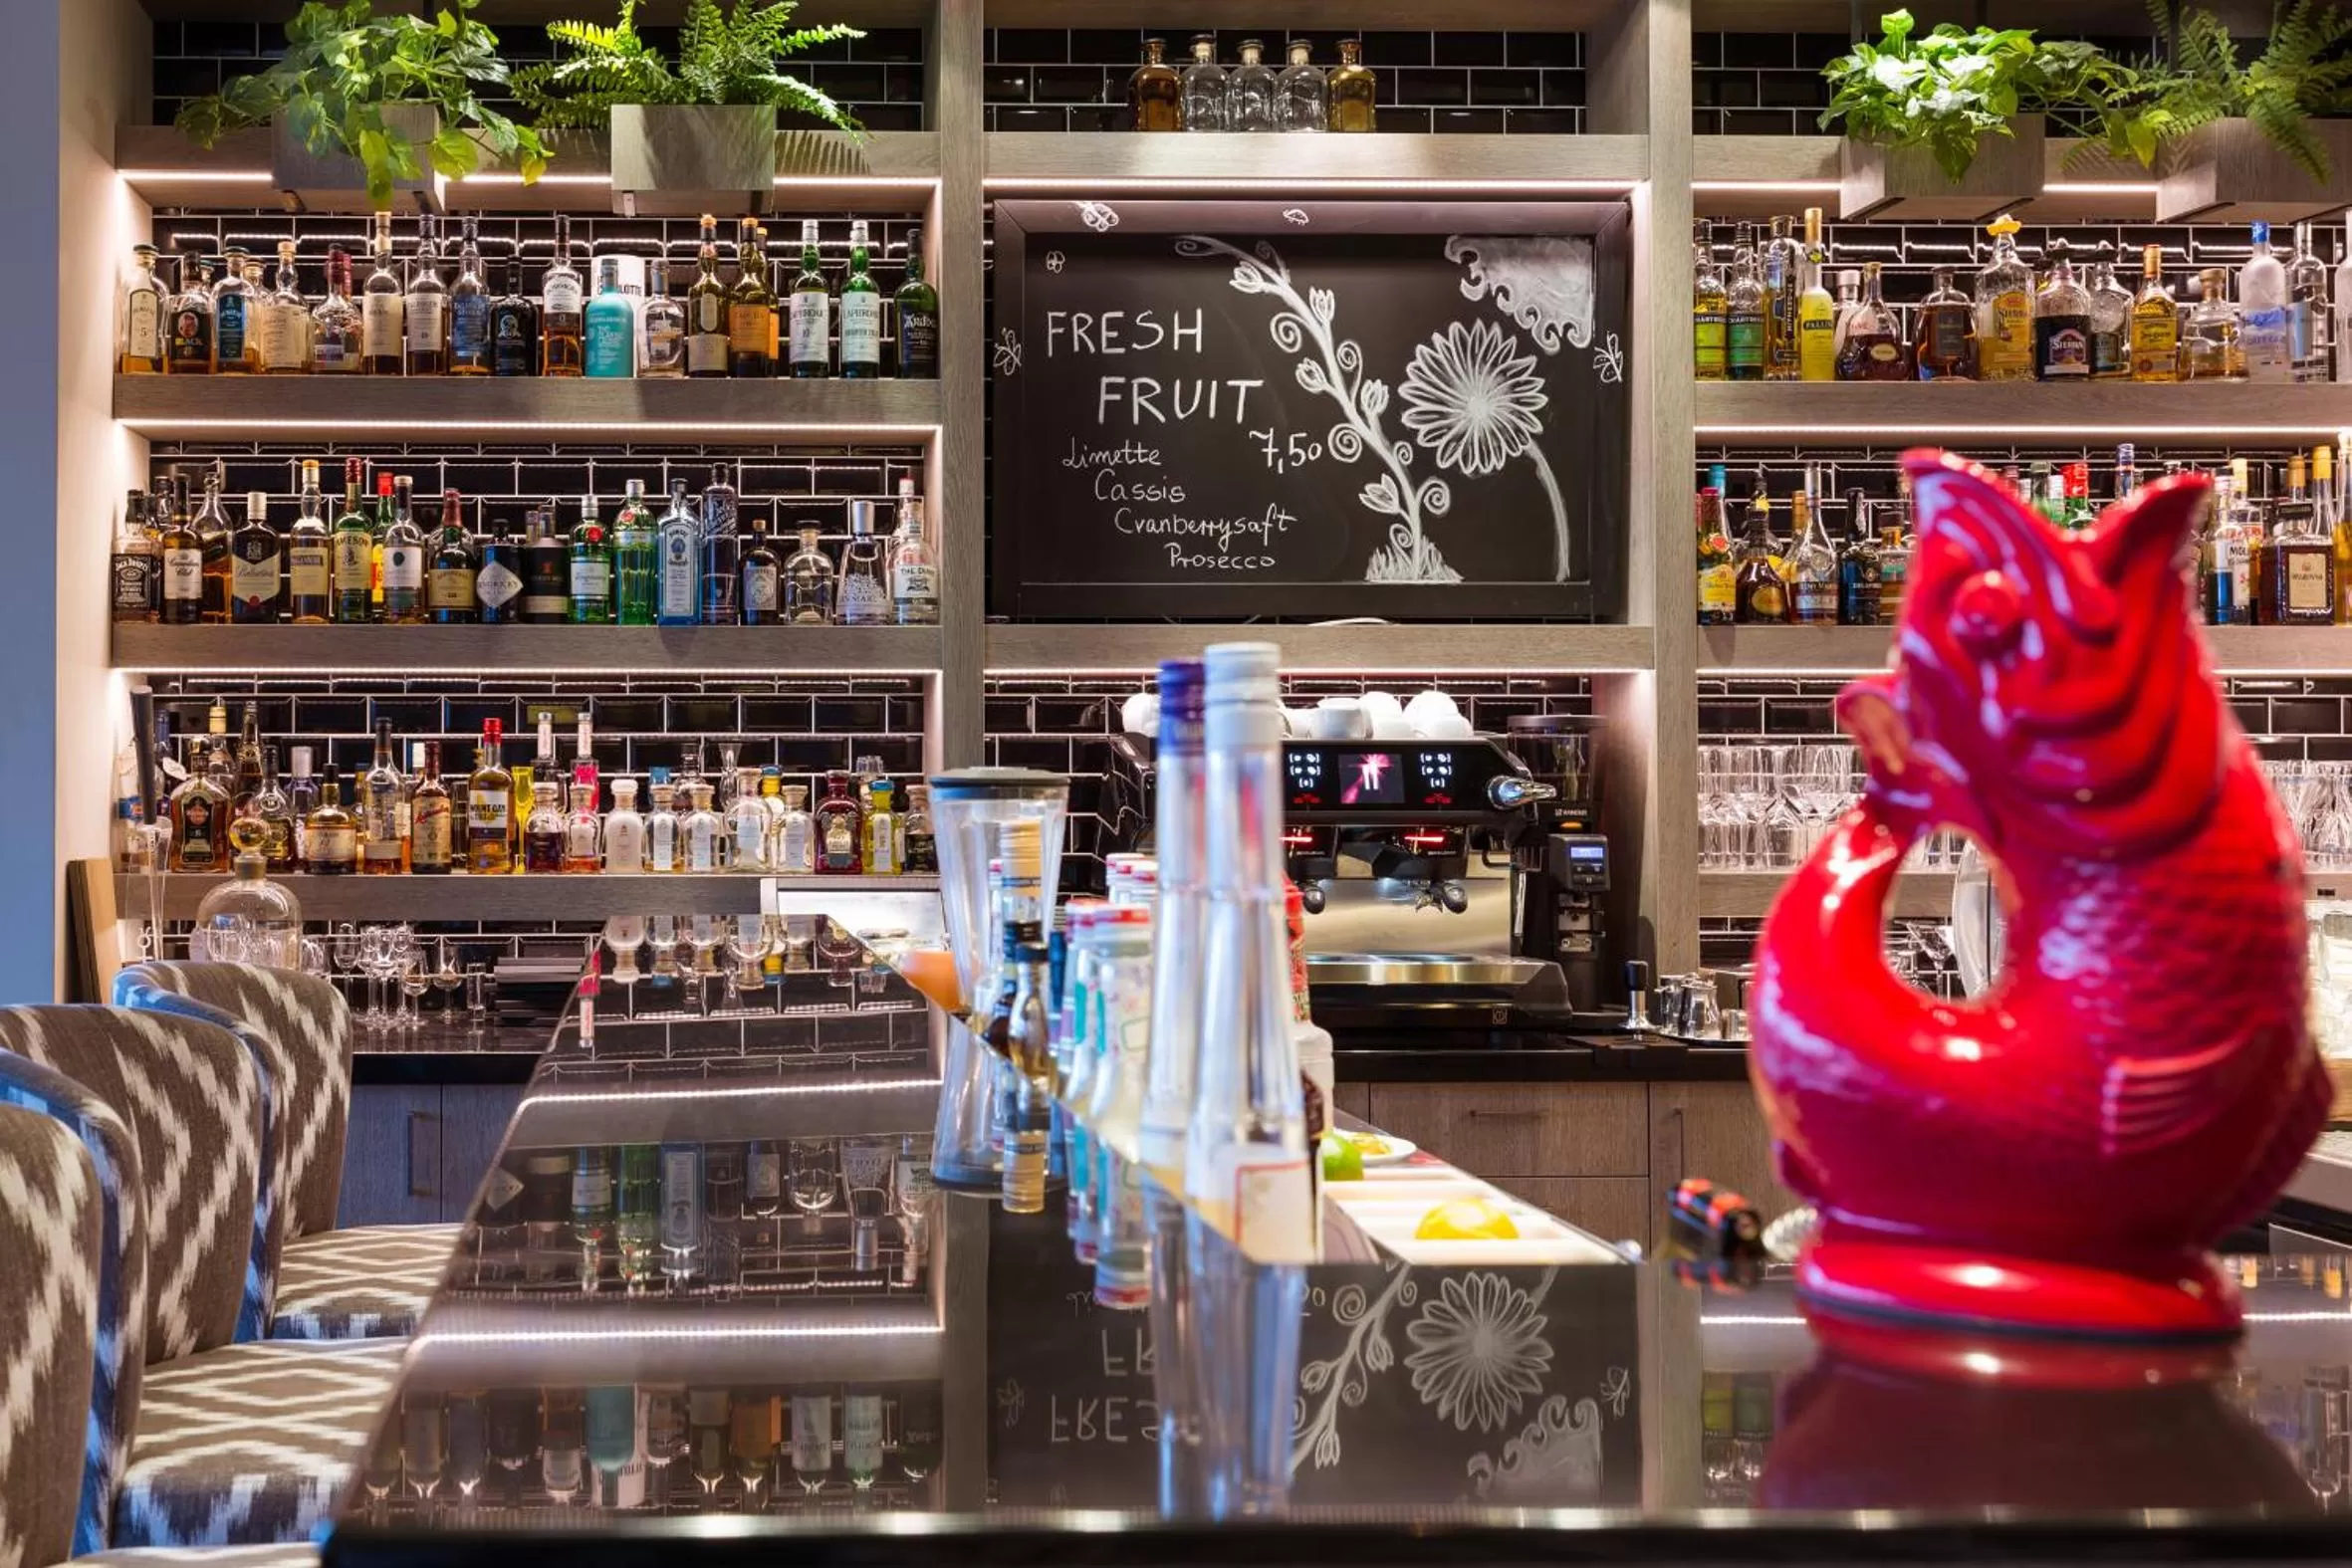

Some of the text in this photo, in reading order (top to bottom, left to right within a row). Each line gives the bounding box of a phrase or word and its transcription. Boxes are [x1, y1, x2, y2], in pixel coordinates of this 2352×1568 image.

[1047, 308, 1202, 356] FRESH
[1098, 376, 1265, 425] FRUIT
[1061, 436, 1162, 468] Limette
[1249, 427, 1322, 474] 7,50
[1094, 468, 1186, 503] Cassis
[1113, 502, 1297, 553] Cranberrysaft
[1163, 542, 1276, 568] Prosecco
